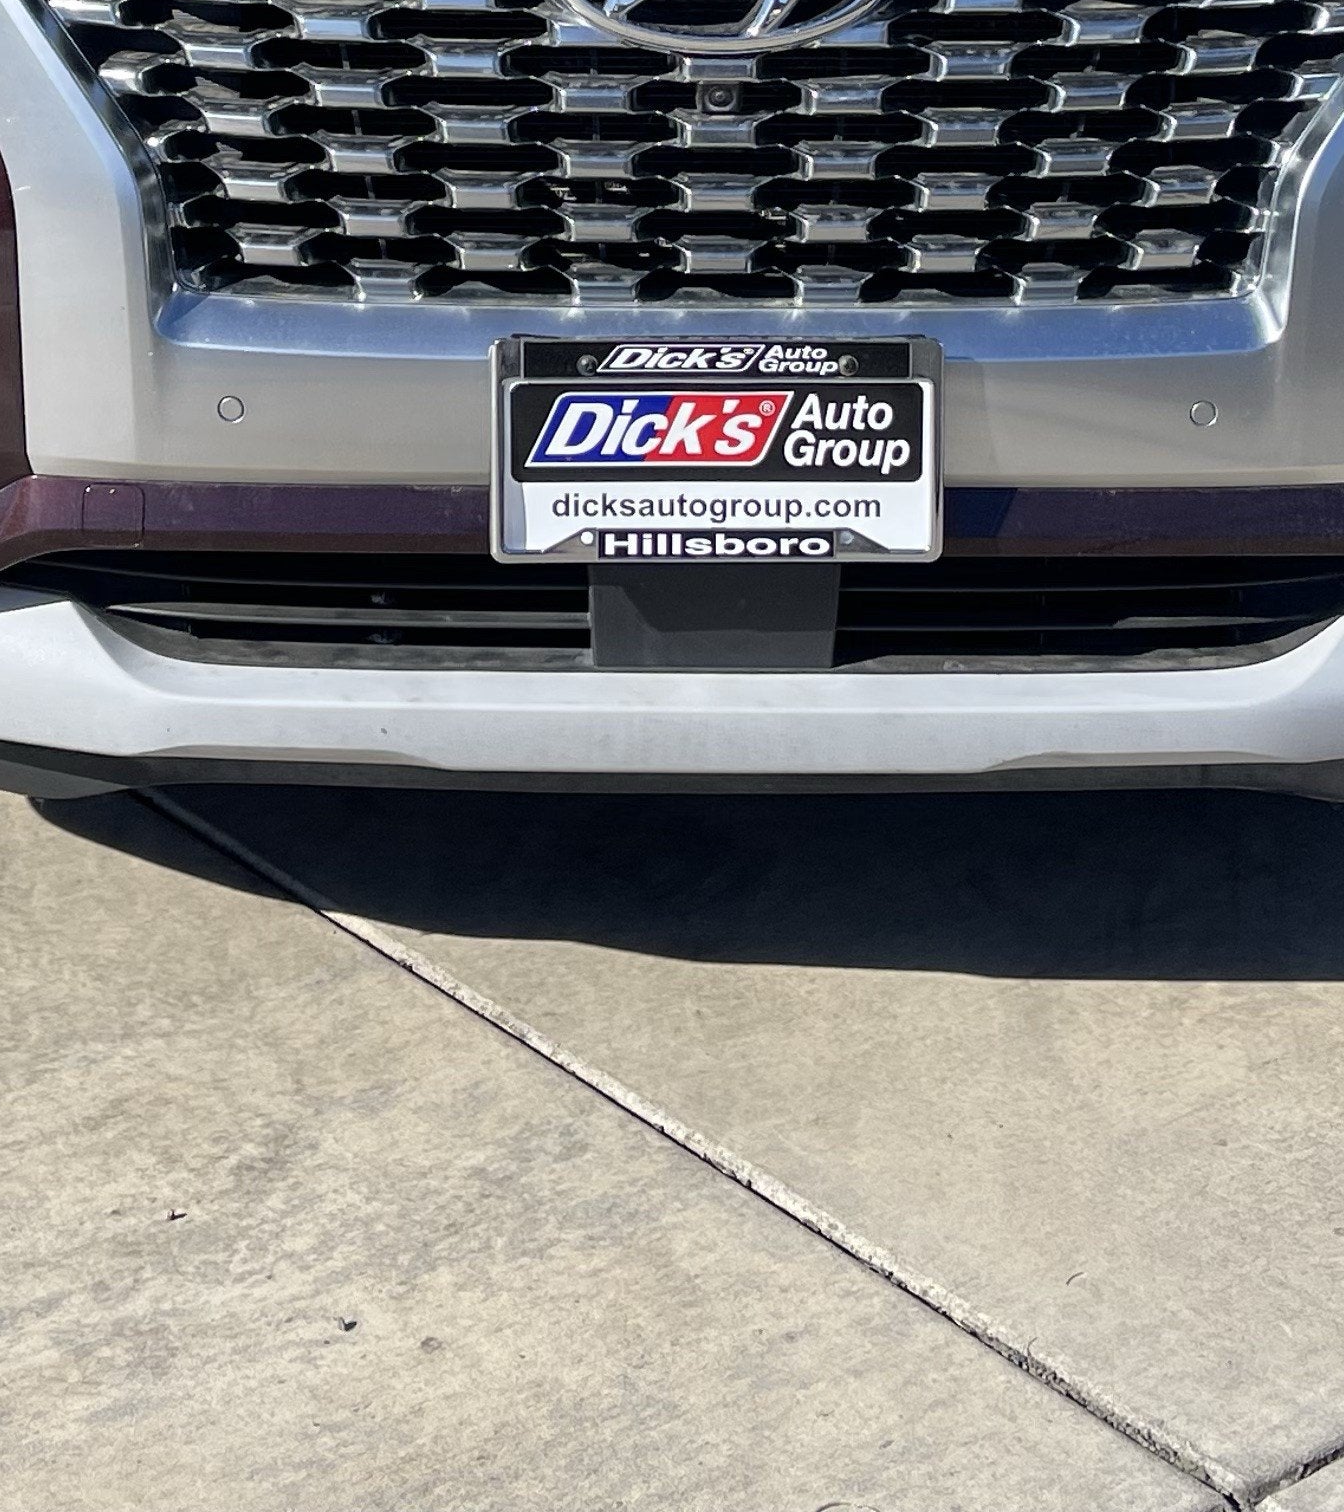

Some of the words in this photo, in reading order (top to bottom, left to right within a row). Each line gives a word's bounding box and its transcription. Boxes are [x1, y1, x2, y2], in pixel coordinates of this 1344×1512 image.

[610, 346, 746, 370] Dick's
[764, 344, 829, 360] Auto
[758, 358, 839, 376] Group
[790, 393, 895, 432] Auto
[544, 398, 759, 457] Dick's
[782, 431, 912, 475] Group
[551, 492, 882, 523] dicksautogroup.com
[603, 530, 832, 555] Hillsboro
